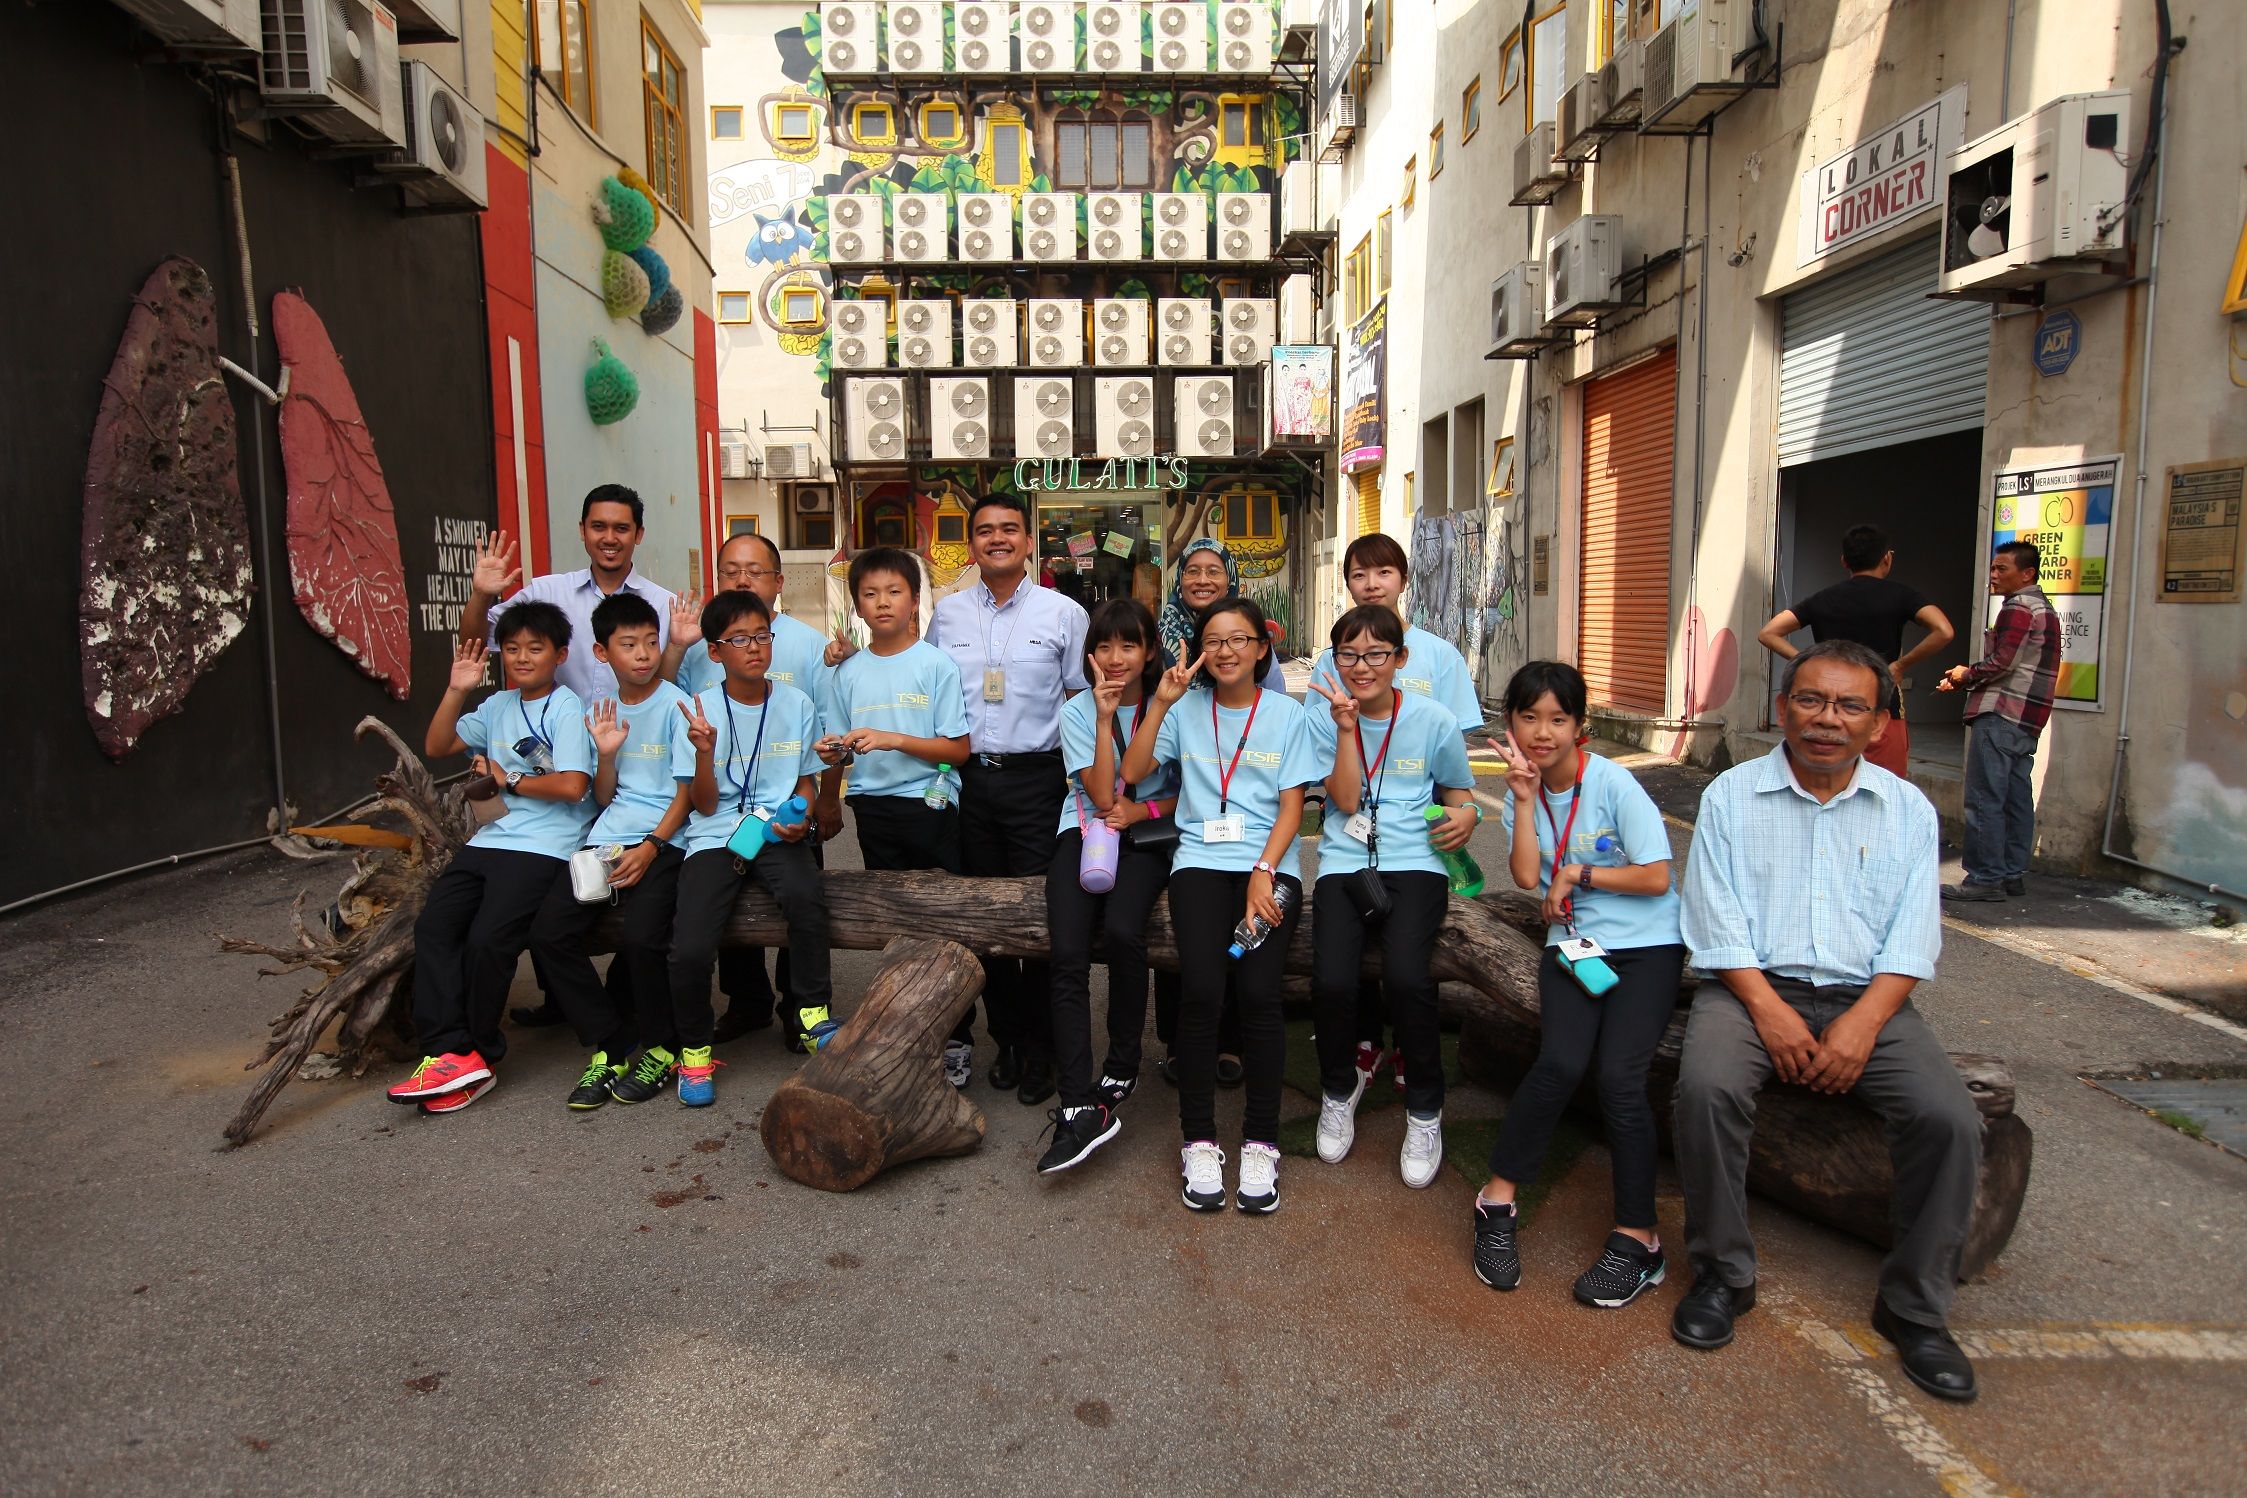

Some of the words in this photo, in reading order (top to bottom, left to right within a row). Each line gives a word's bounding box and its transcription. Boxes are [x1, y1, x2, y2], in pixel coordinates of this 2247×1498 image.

[1827, 118, 1928, 195] LOKAL
[710, 174, 775, 219] Seni
[776, 164, 797, 198] 7
[1824, 160, 1927, 243] CORNER
[2041, 328, 2073, 355] ADT
[1014, 455, 1188, 491] GULATI'S
[1997, 481, 2016, 491] PROJEK
[2035, 474, 2068, 486] MERANGKUL
[2069, 473, 2080, 483] DUA
[2081, 469, 2113, 482] ANUGERAH
[435, 516, 443, 543] A
[444, 518, 488, 546] SMOKER
[2023, 532, 2063, 544] GREEN
[438, 545, 461, 573] MAY
[420, 603, 444, 631] THE
[1400, 678, 1432, 691] TSIE
[895, 693, 929, 705] TSIE
[770, 741, 802, 752] TSIE
[1244, 750, 1281, 763] TSIE
